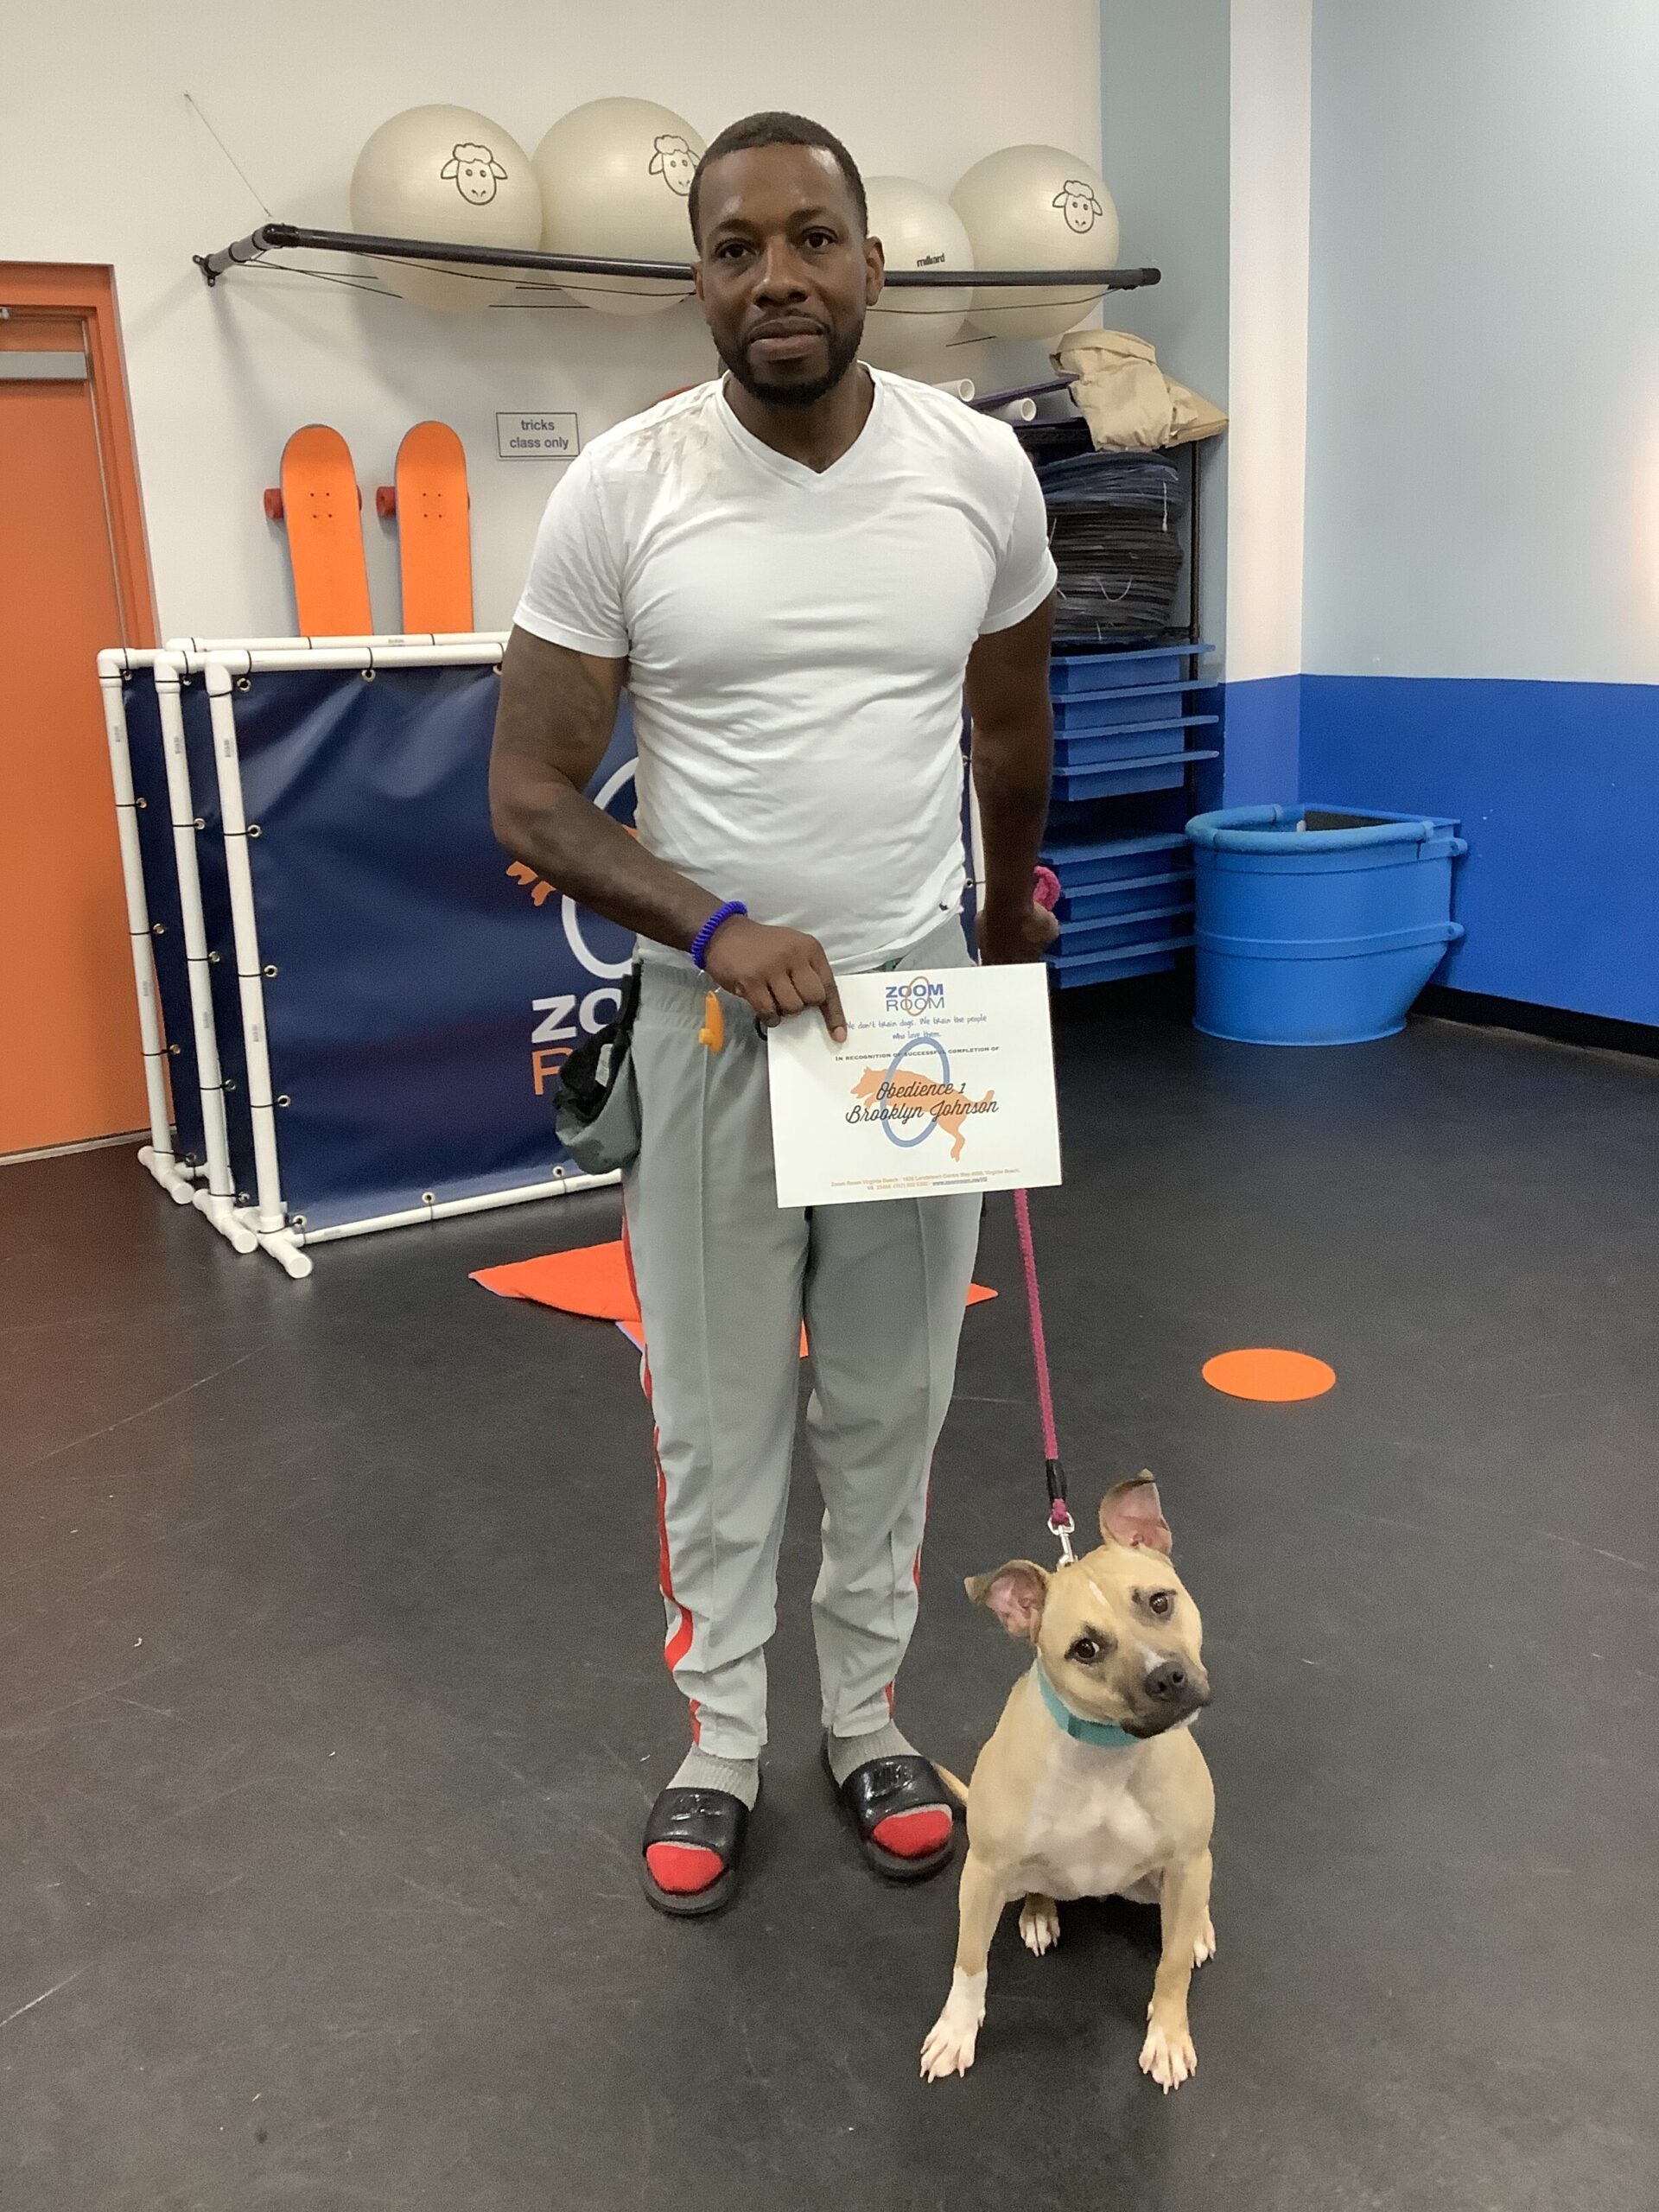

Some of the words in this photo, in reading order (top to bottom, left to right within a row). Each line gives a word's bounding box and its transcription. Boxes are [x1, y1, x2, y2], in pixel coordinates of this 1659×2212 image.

[521, 419, 555, 431] tricks
[510, 436, 541, 448] class
[544, 436, 569, 450] only
[886, 983, 944, 998] ZOOM
[886, 997, 944, 1012] ROOM
[858, 1020, 875, 1029] don't
[878, 1020, 897, 1028] train
[919, 1016, 931, 1025] We
[933, 1016, 951, 1025] train
[967, 1013, 987, 1023] people
[876, 1082, 954, 1101] Obedience
[957, 1082, 967, 1094] 1
[845, 1103, 925, 1125] Brooklyn
[930, 1100, 1000, 1122] Johnson
